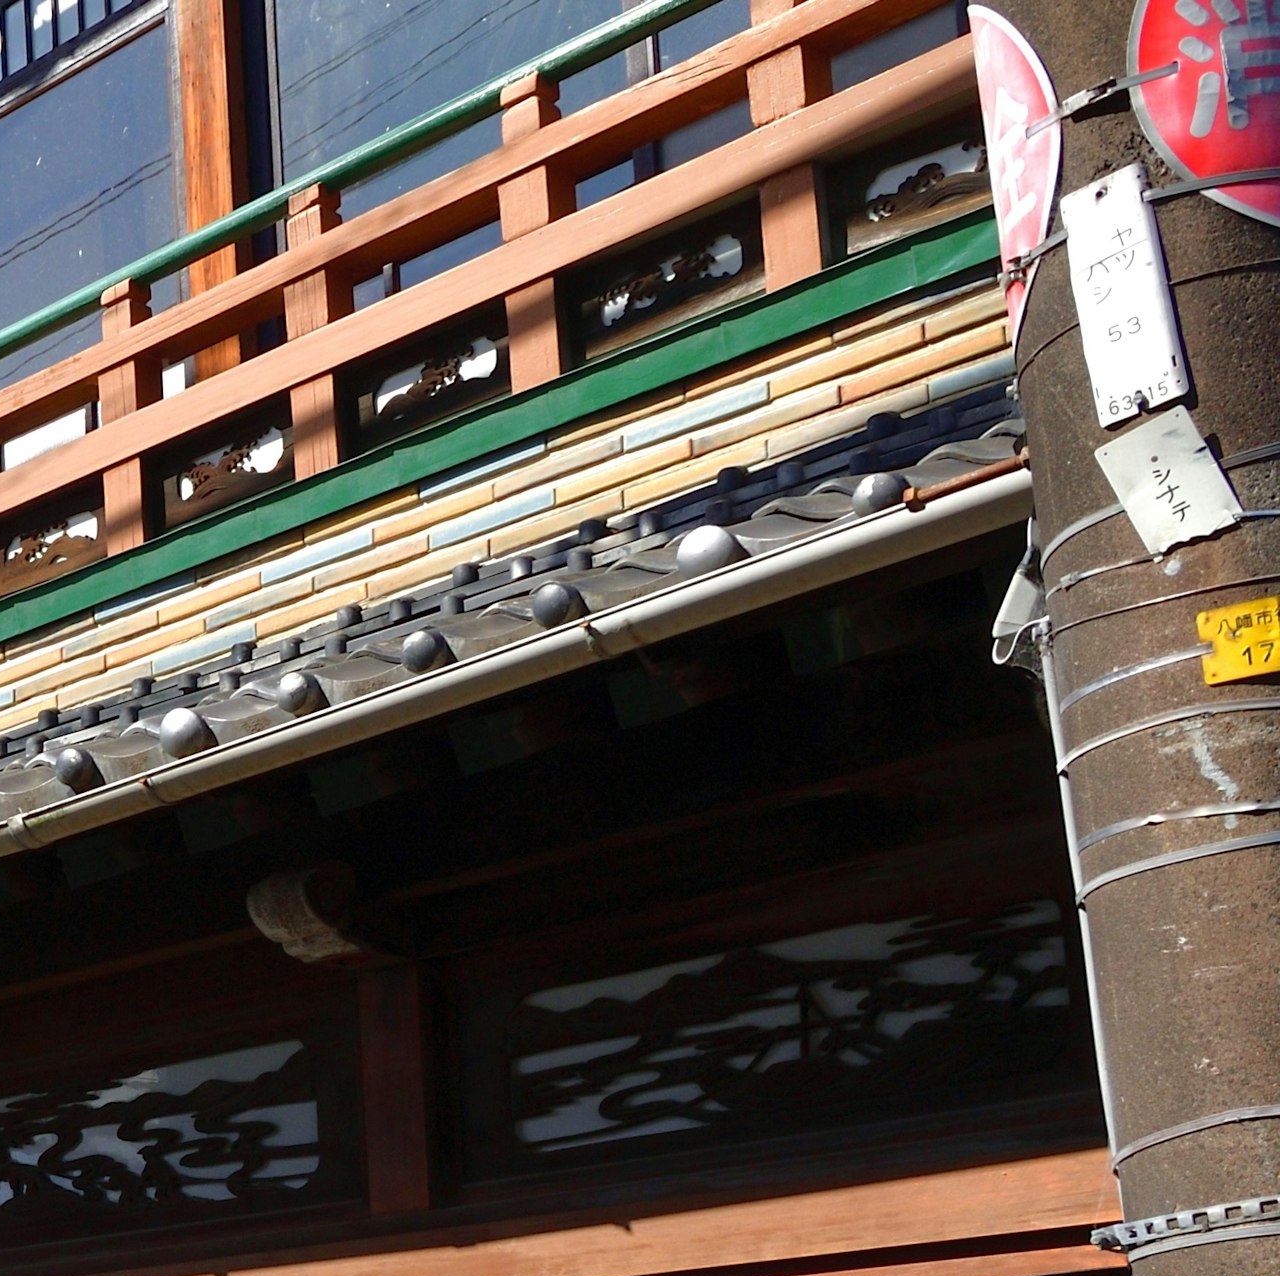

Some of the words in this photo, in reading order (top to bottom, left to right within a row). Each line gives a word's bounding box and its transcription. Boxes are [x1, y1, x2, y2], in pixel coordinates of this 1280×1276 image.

[1108, 316, 1142, 343] 53
[1217, 609, 1280, 636] 八幡市
